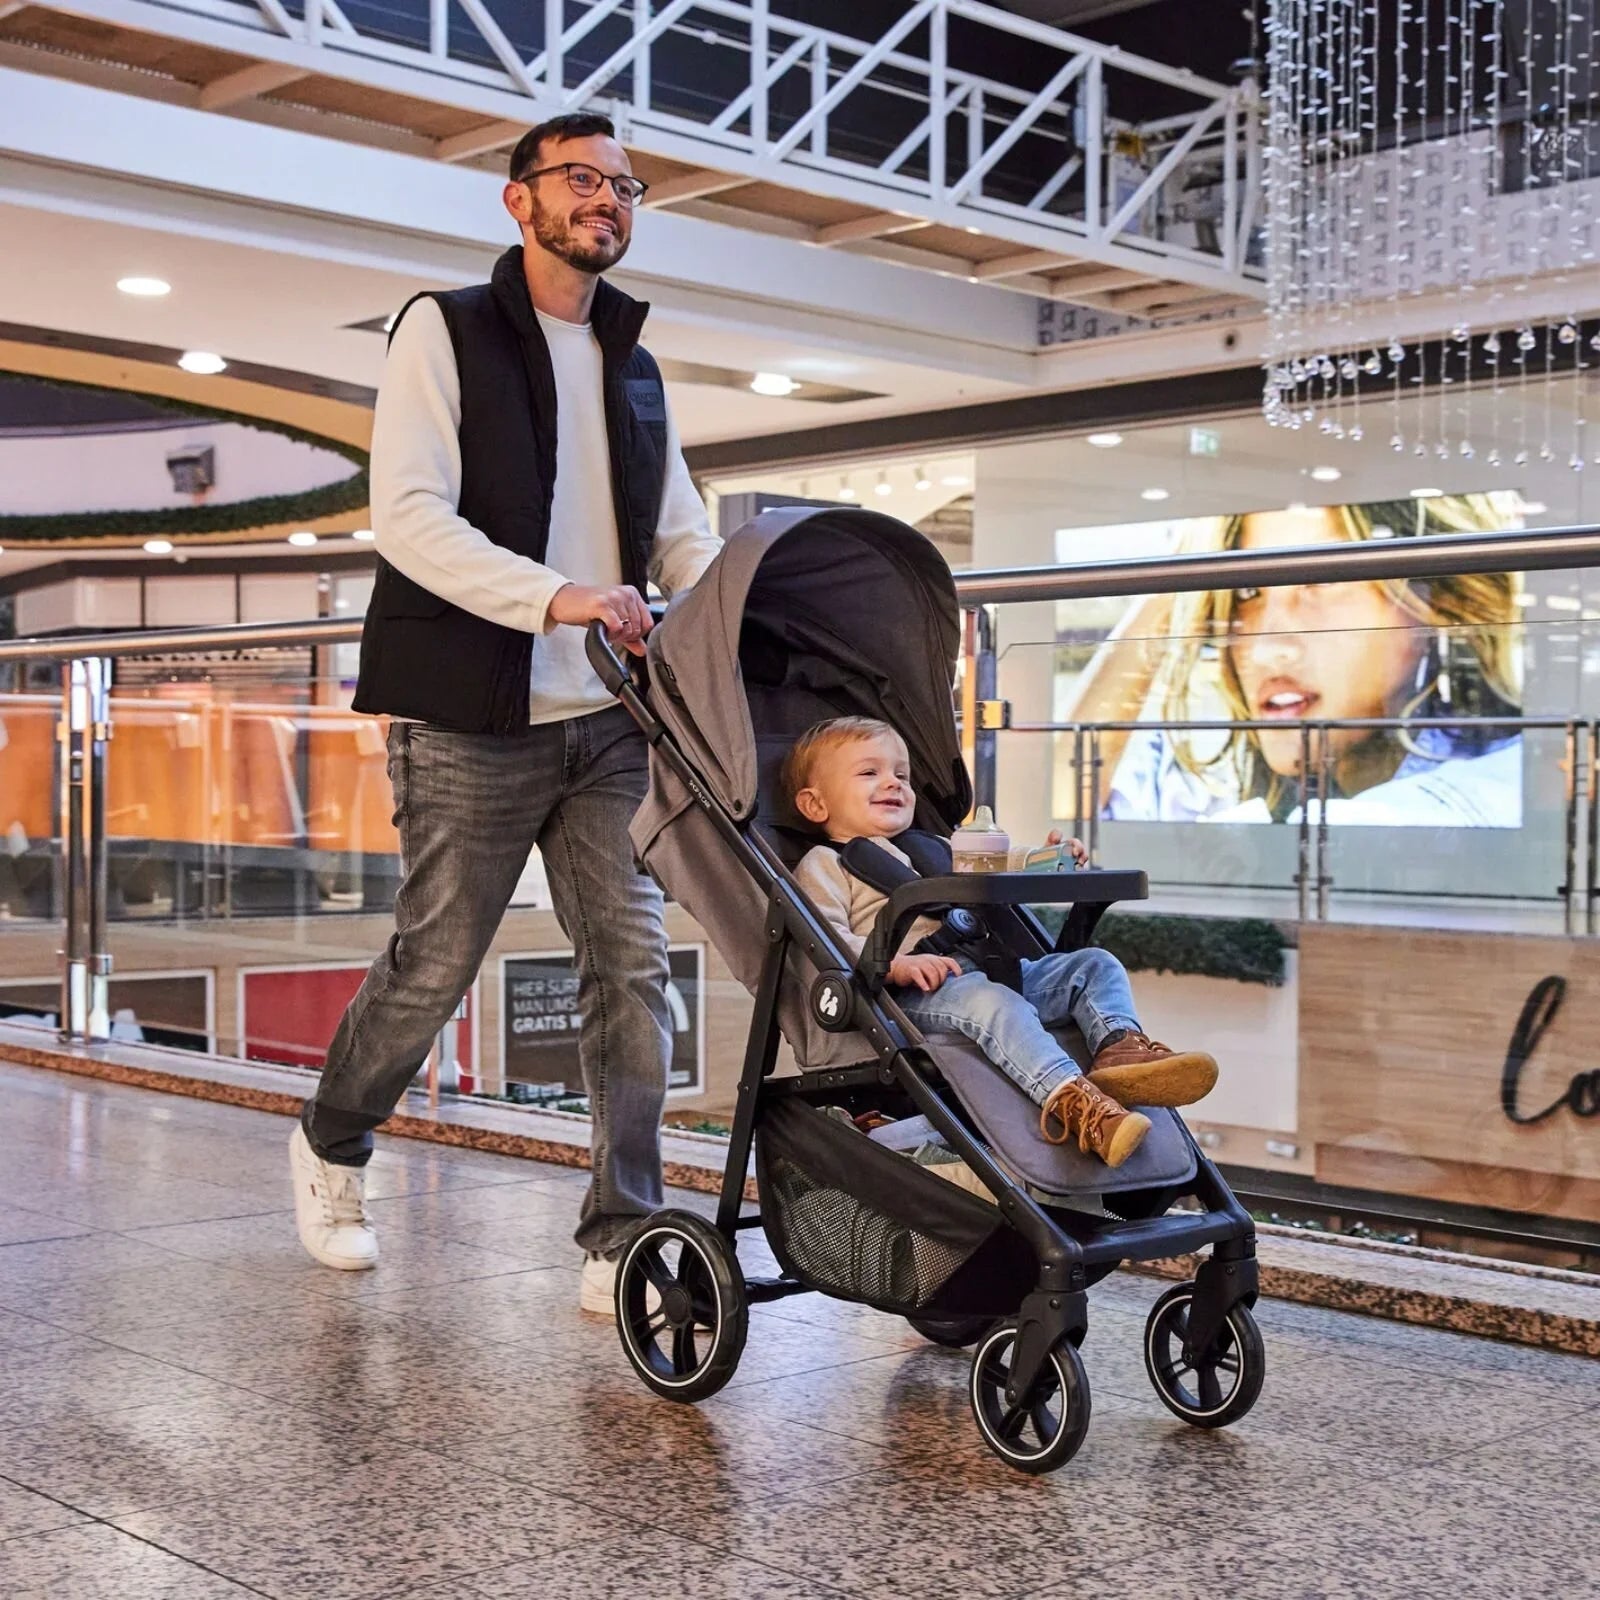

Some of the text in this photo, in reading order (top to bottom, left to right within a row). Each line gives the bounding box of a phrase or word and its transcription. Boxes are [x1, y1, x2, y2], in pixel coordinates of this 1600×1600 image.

[512, 981, 545, 997] HIER
[513, 999, 544, 1014] MAN
[512, 1014, 567, 1033] GRATIS
